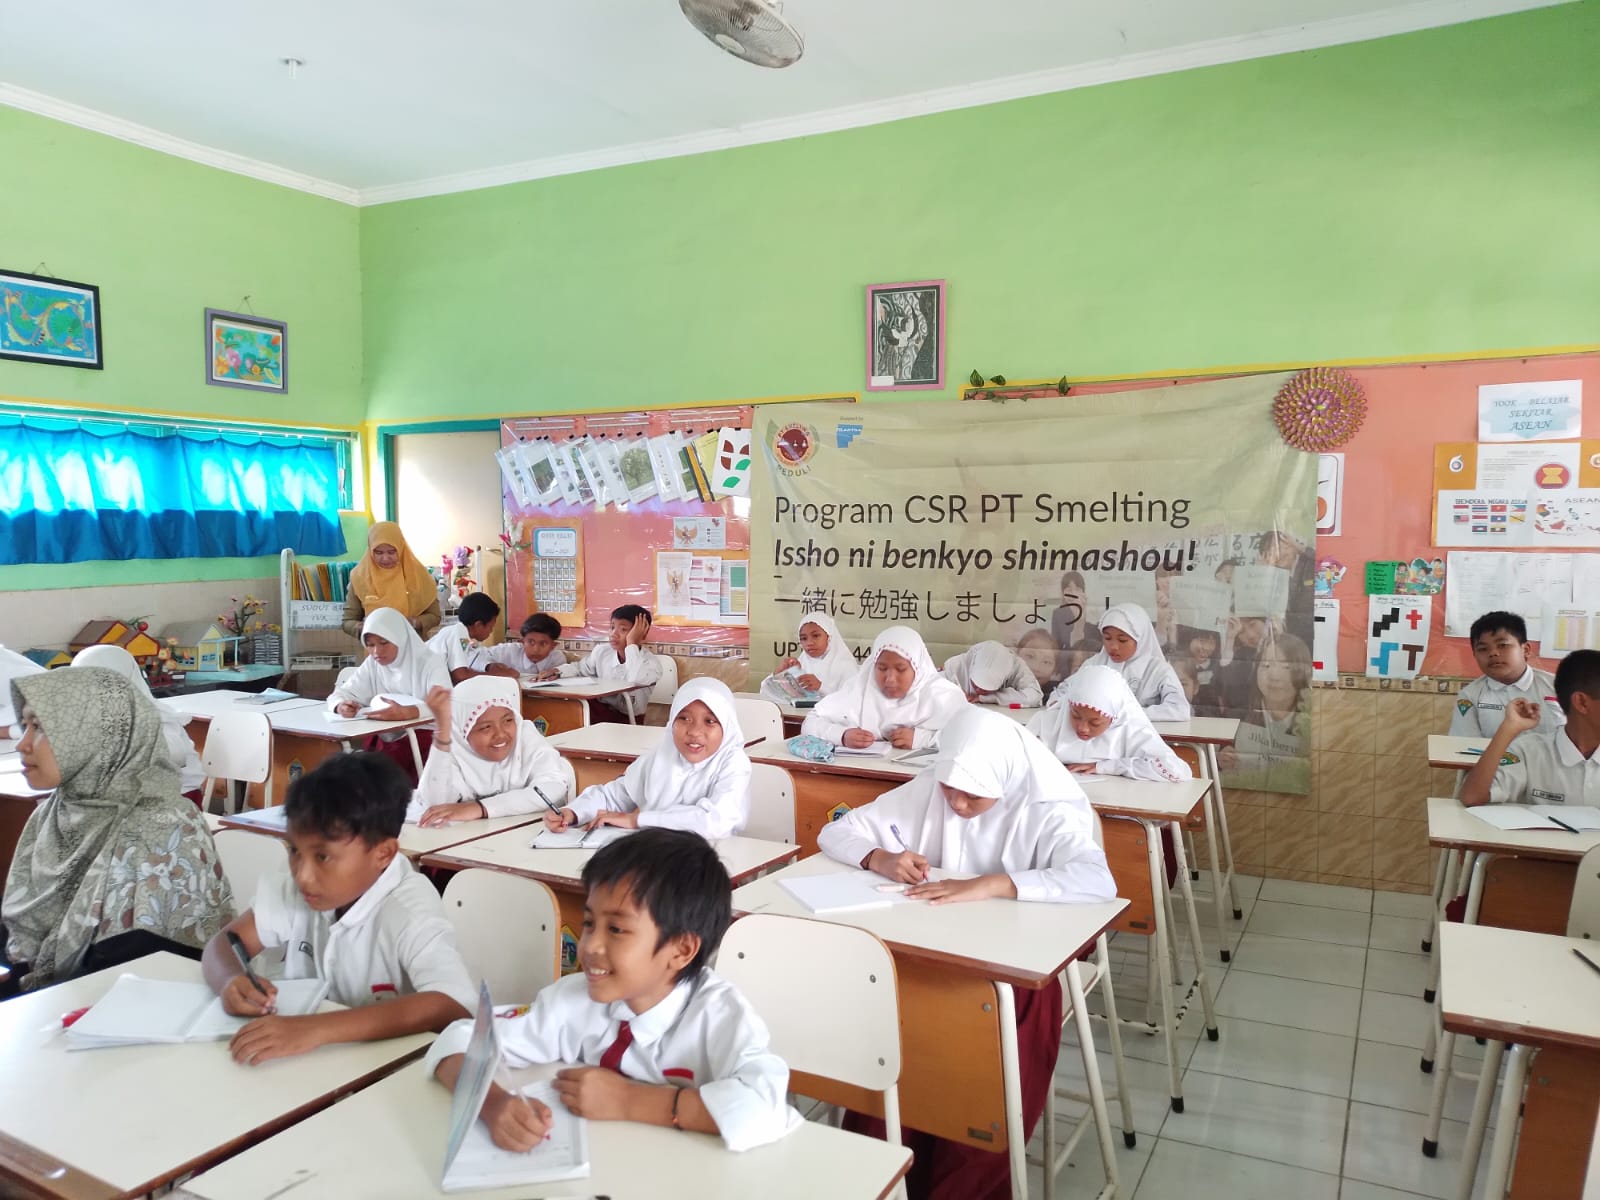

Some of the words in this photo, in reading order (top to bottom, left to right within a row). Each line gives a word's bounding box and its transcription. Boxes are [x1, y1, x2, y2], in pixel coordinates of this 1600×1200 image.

[775, 496, 893, 530] Program
[904, 494, 969, 524] CSR
[981, 494, 1023, 523] PT
[1035, 491, 1191, 529] Smelting
[775, 539, 840, 567] Issho
[849, 540, 875, 568] ni
[882, 540, 993, 575] benkyo
[1002, 540, 1196, 571] shimashou!
[774, 641, 801, 657] UP
